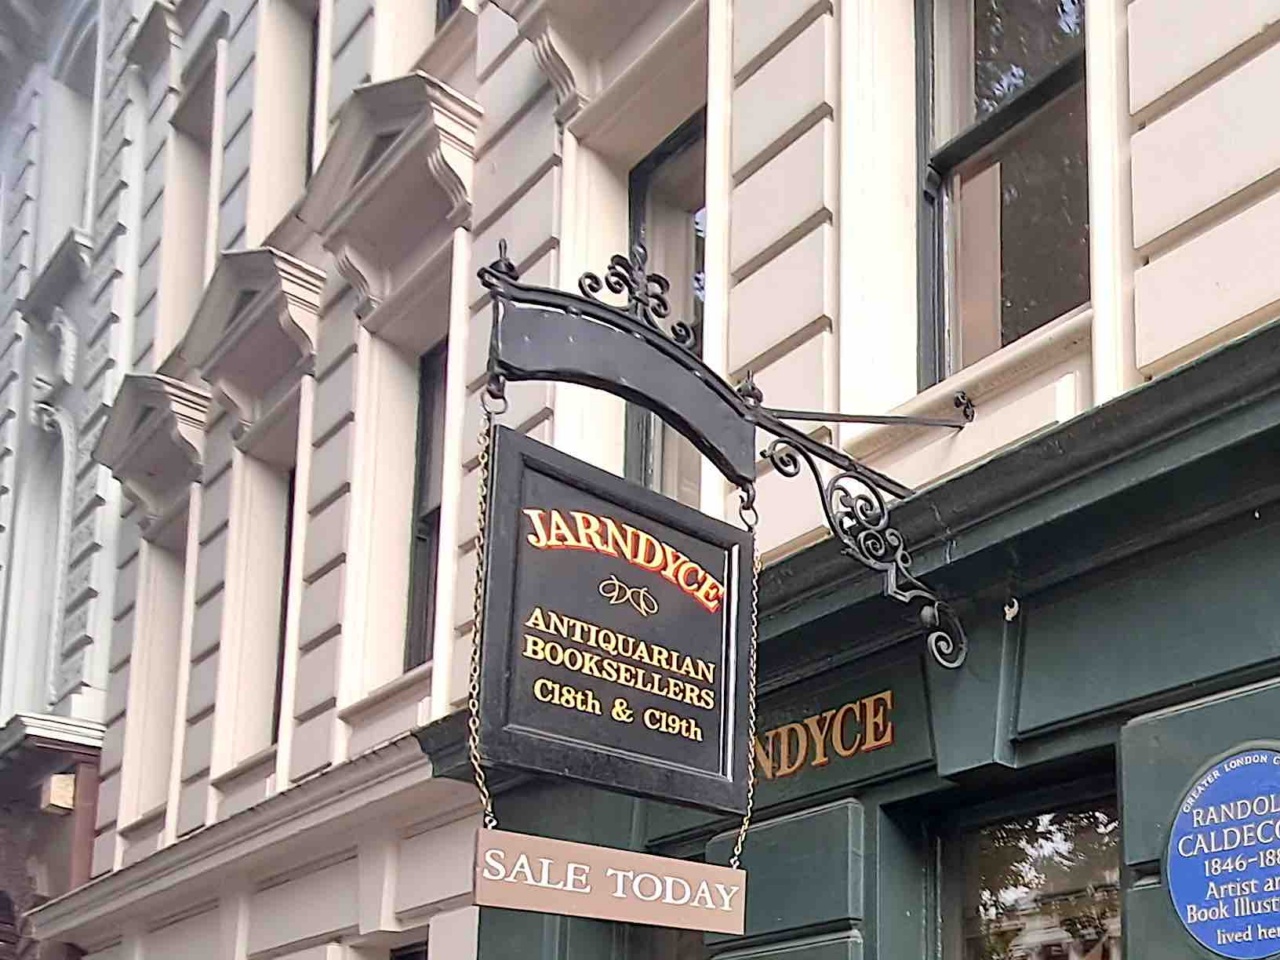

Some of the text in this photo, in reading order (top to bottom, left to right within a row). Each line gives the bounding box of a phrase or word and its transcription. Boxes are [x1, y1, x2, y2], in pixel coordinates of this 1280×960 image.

[522, 507, 725, 613] JARNDYCE
[522, 633, 716, 711] BOOKSELLERS
[524, 607, 716, 683] ANTIQUARIAN
[611, 697, 635, 724] &
[1182, 768, 1222, 814] GREATER
[1224, 754, 1268, 773] LONDON
[481, 848, 740, 911] SALE TODAY
[1205, 877, 1258, 901] Artist
[1186, 902, 1230, 924] Book
[1216, 924, 1253, 945] lived
